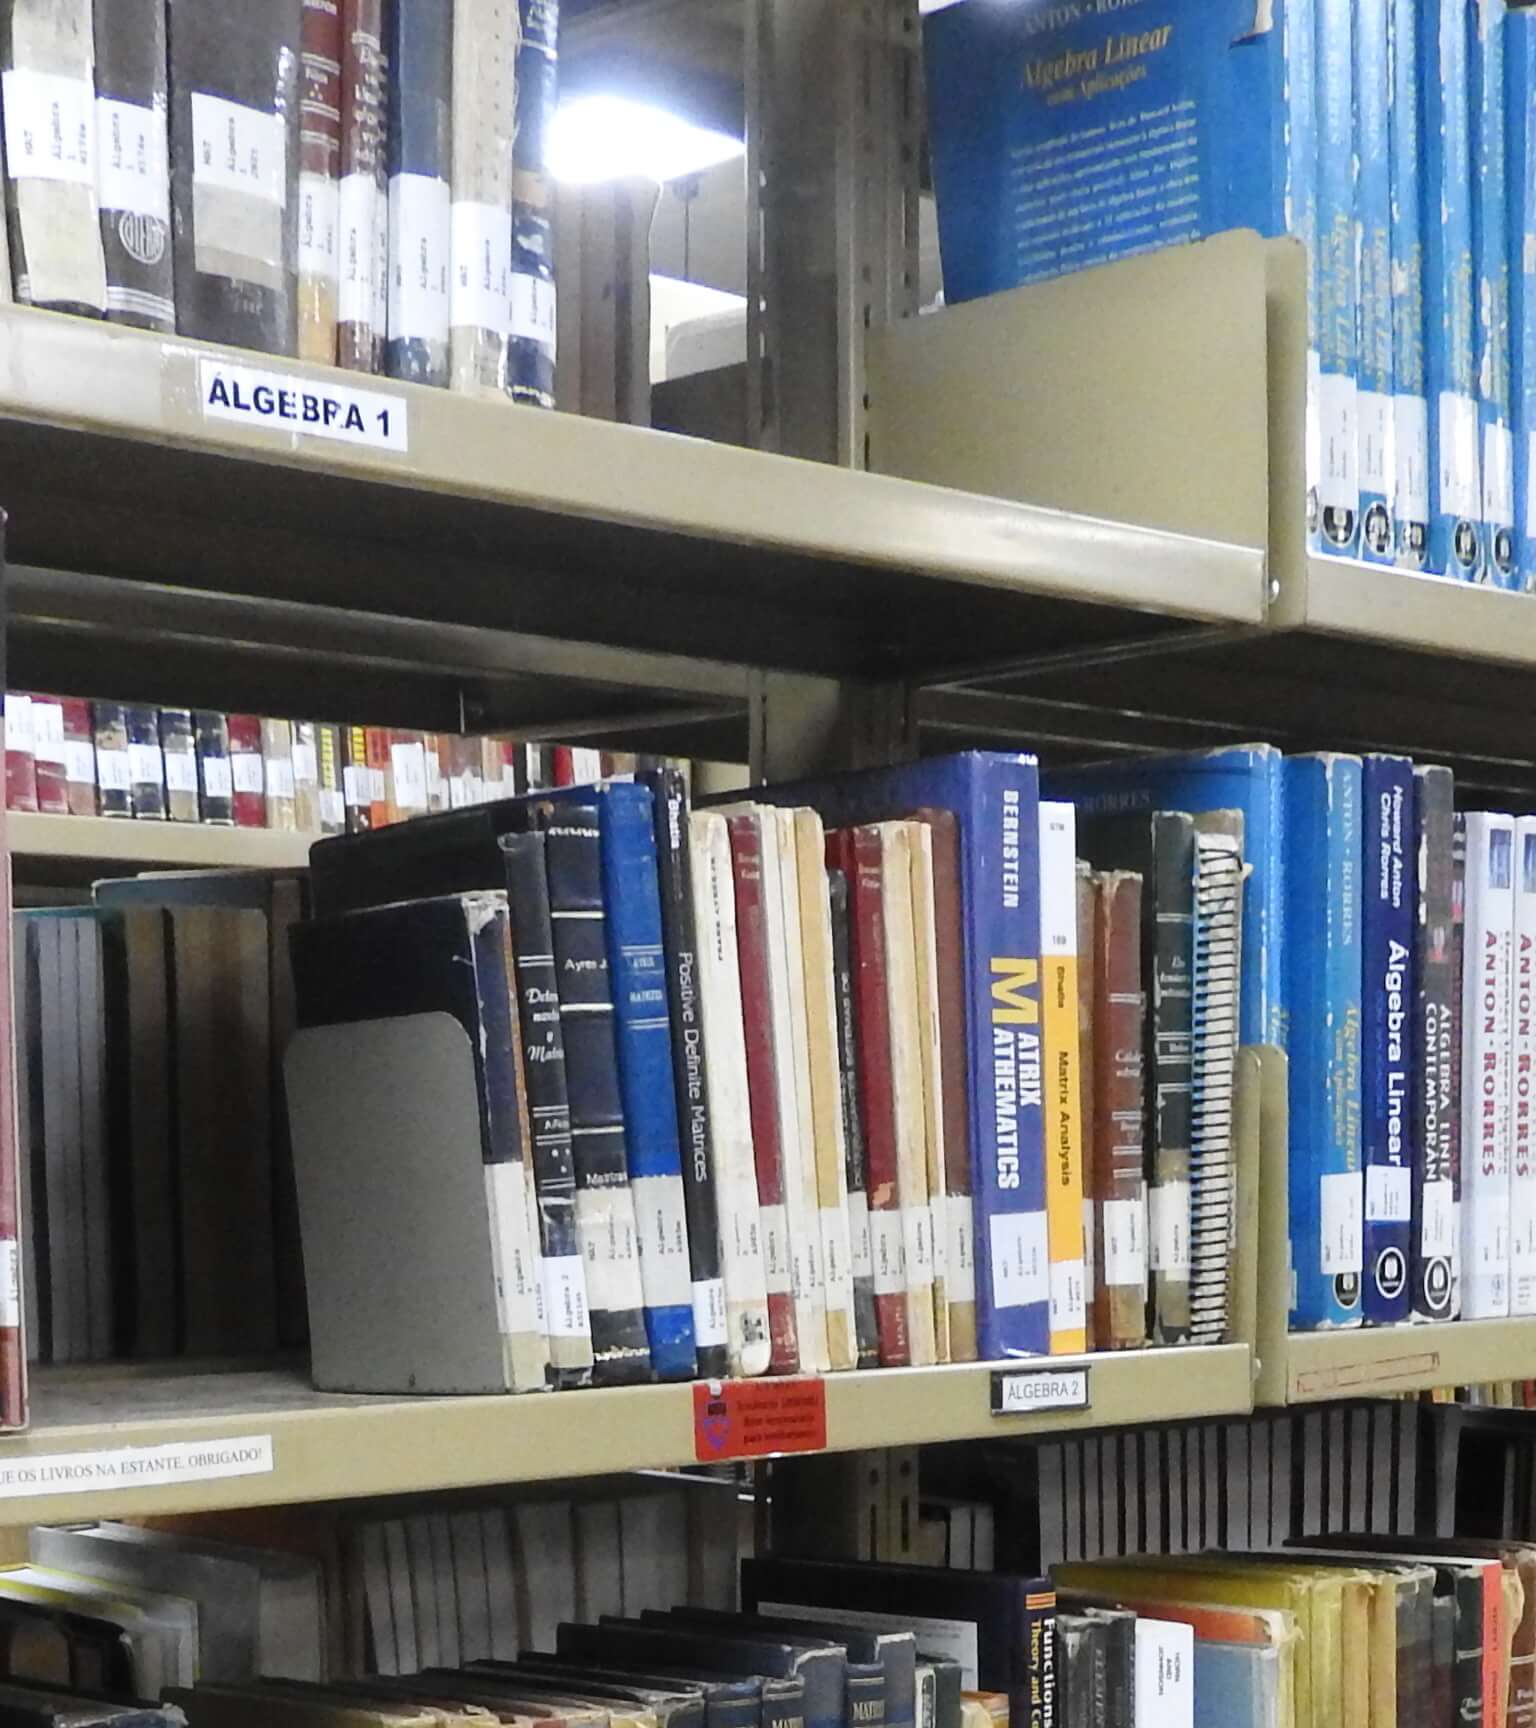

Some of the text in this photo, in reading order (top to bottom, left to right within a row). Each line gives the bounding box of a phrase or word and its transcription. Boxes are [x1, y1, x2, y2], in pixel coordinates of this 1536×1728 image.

[208, 376, 391, 437] ÁLGEBRA 1
[1001, 789, 1020, 908] BERNSTEIN
[678, 951, 708, 1184] Positive Definite Matrices
[1384, 939, 1412, 1167] Álgebra Linear
[1481, 930, 1499, 1177] ANTON RORRES
[1515, 932, 1533, 1178] ANTON RORRES
[1057, 1051, 1071, 1187] Matrix Analysis
[1070, 1379, 1080, 1397] 2
[18, 1469, 38, 1484] OS
[40, 1464, 94, 1483] LIVROS
[96, 1461, 116, 1477] NA
[1030, 1618, 1042, 1673] Theory
